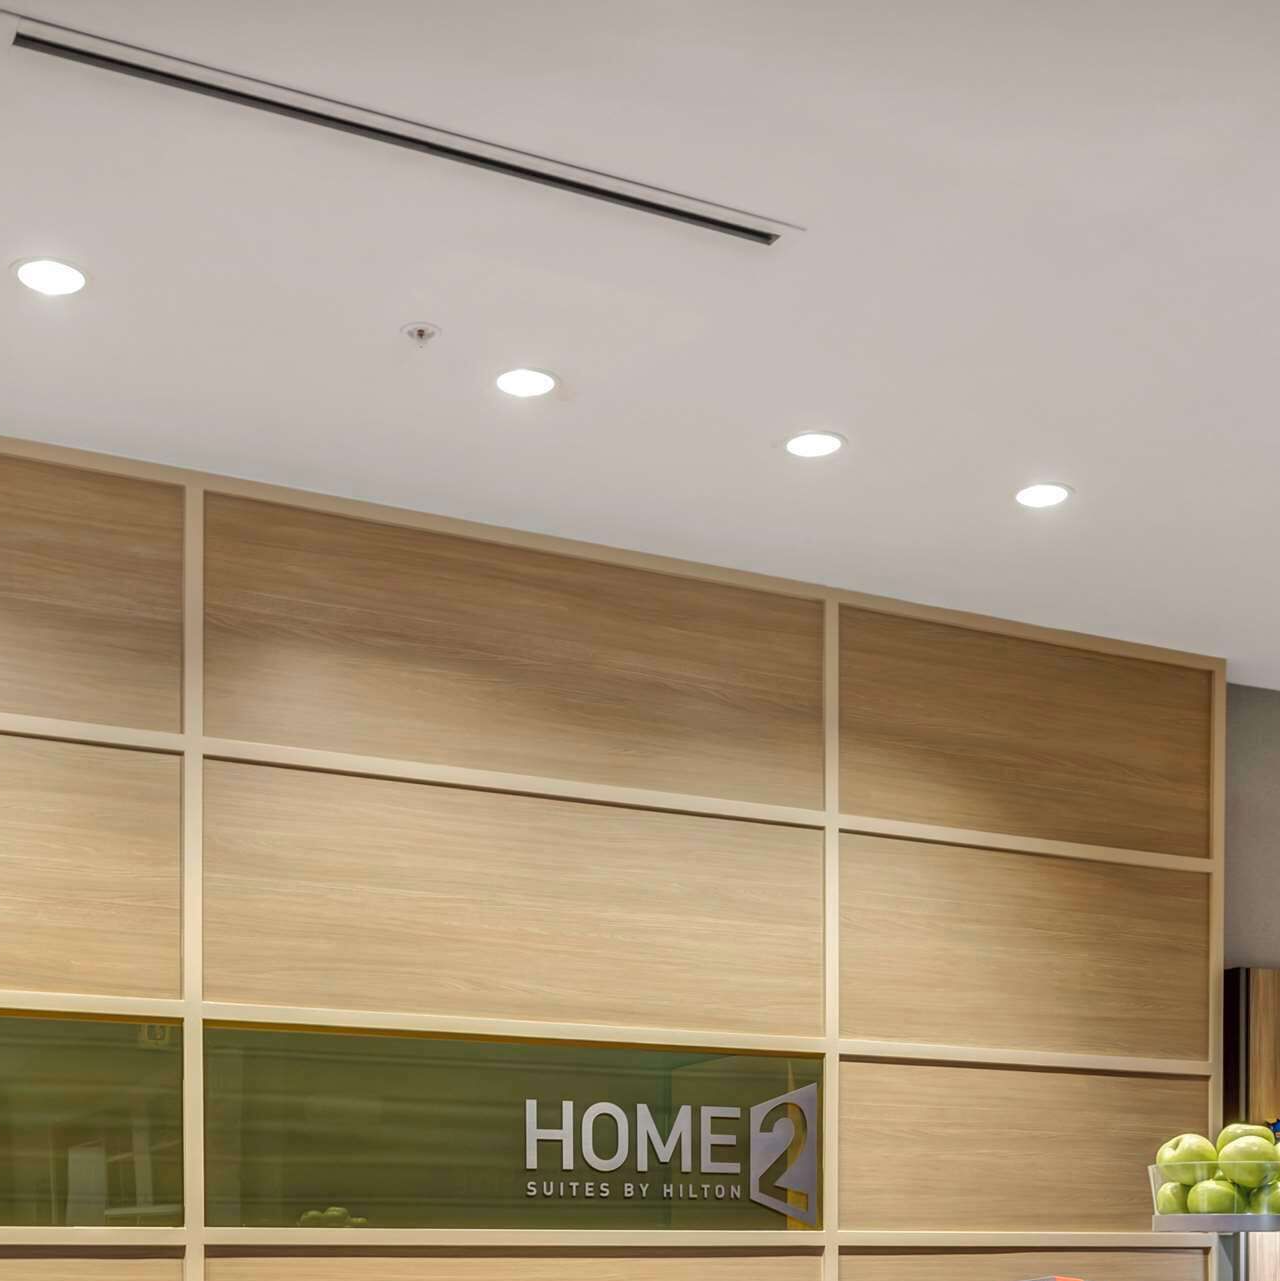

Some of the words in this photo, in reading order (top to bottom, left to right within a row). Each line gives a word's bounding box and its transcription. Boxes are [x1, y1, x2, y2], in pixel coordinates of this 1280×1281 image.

[525, 1098, 741, 1174] HOME
[525, 1181, 610, 1198] SUITES
[623, 1183, 650, 1198] BY
[663, 1183, 742, 1200] HILTON
